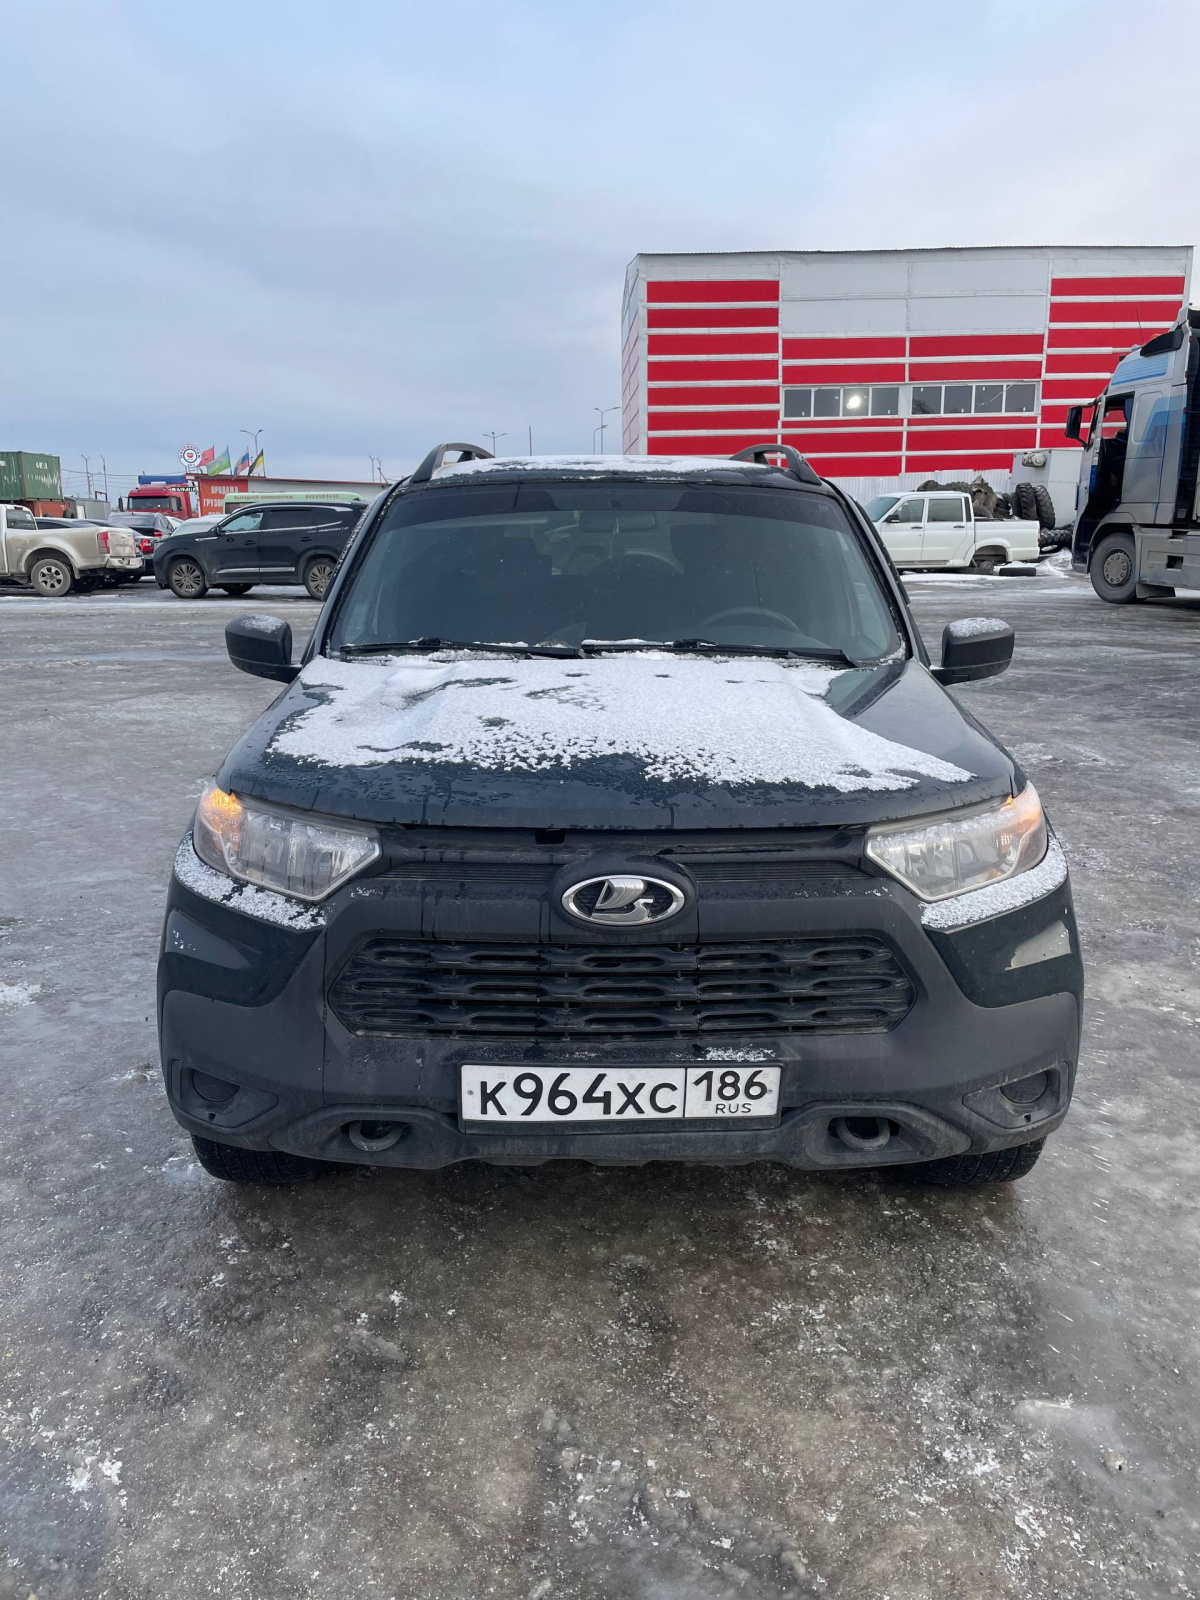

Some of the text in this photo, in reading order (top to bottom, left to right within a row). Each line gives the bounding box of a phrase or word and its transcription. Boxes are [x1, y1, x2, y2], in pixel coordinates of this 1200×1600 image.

[479, 1072, 678, 1116] К964ХС
[693, 1069, 768, 1102] 186
[715, 1103, 752, 1114] RUS
